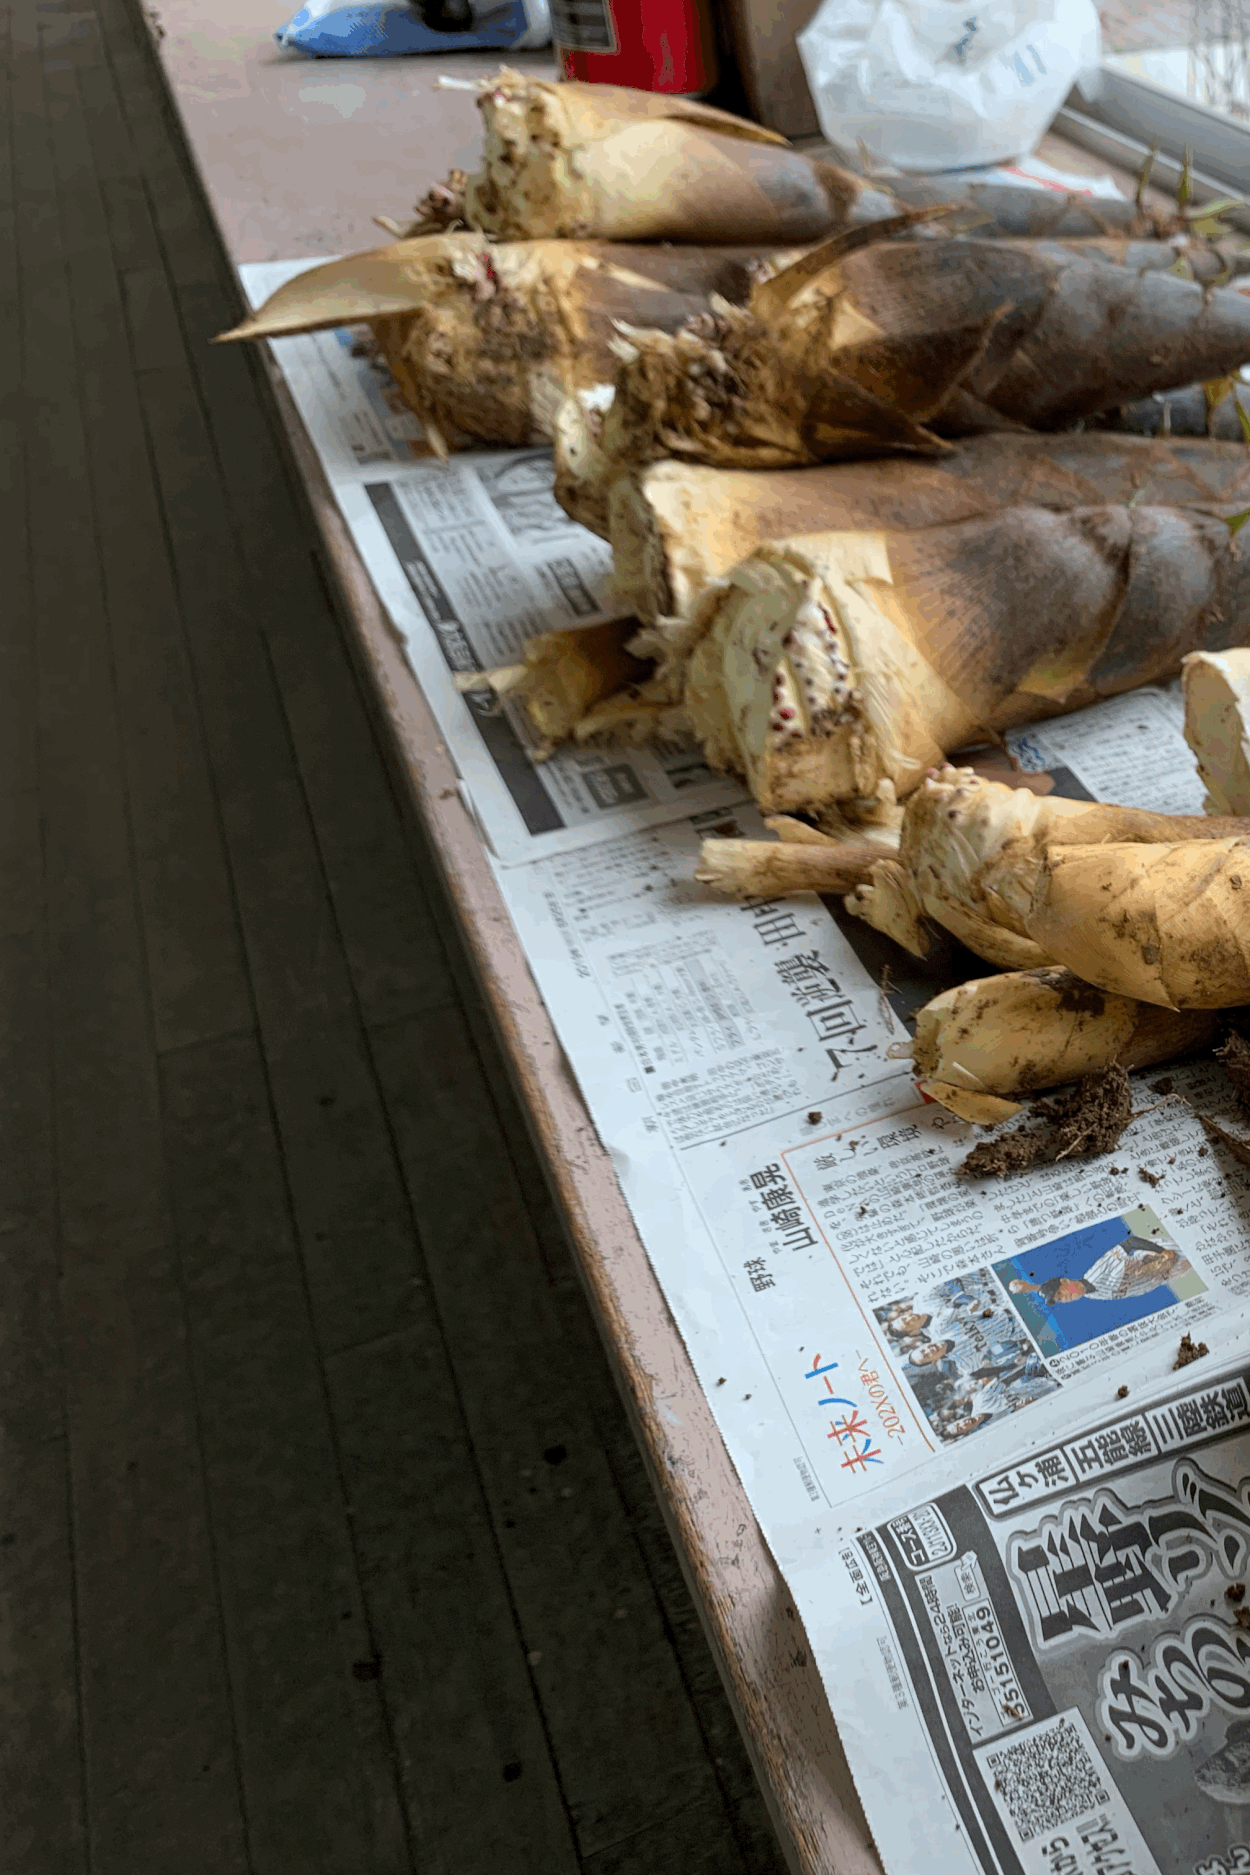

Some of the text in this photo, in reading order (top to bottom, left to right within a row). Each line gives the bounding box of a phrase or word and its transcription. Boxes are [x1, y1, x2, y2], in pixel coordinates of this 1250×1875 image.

[770, 947, 884, 1070] 7回逆襲
[811, 1122, 923, 1172] 厳しい環境
[747, 1160, 818, 1255] 山崎康晃
[741, 1254, 777, 1293] 野球
[795, 1347, 886, 1479] 未来ノート
[984, 1452, 1071, 1508] 仏ヶ浦
[1069, 1418, 1156, 1474] 五能線
[891, 1515, 928, 1566] コース番号
[957, 1570, 978, 1595] 検索
[917, 1573, 986, 1737] インターネットなら24時間
[944, 1601, 986, 1694] お申込み可能!
[1037, 1833, 1084, 1875] から
